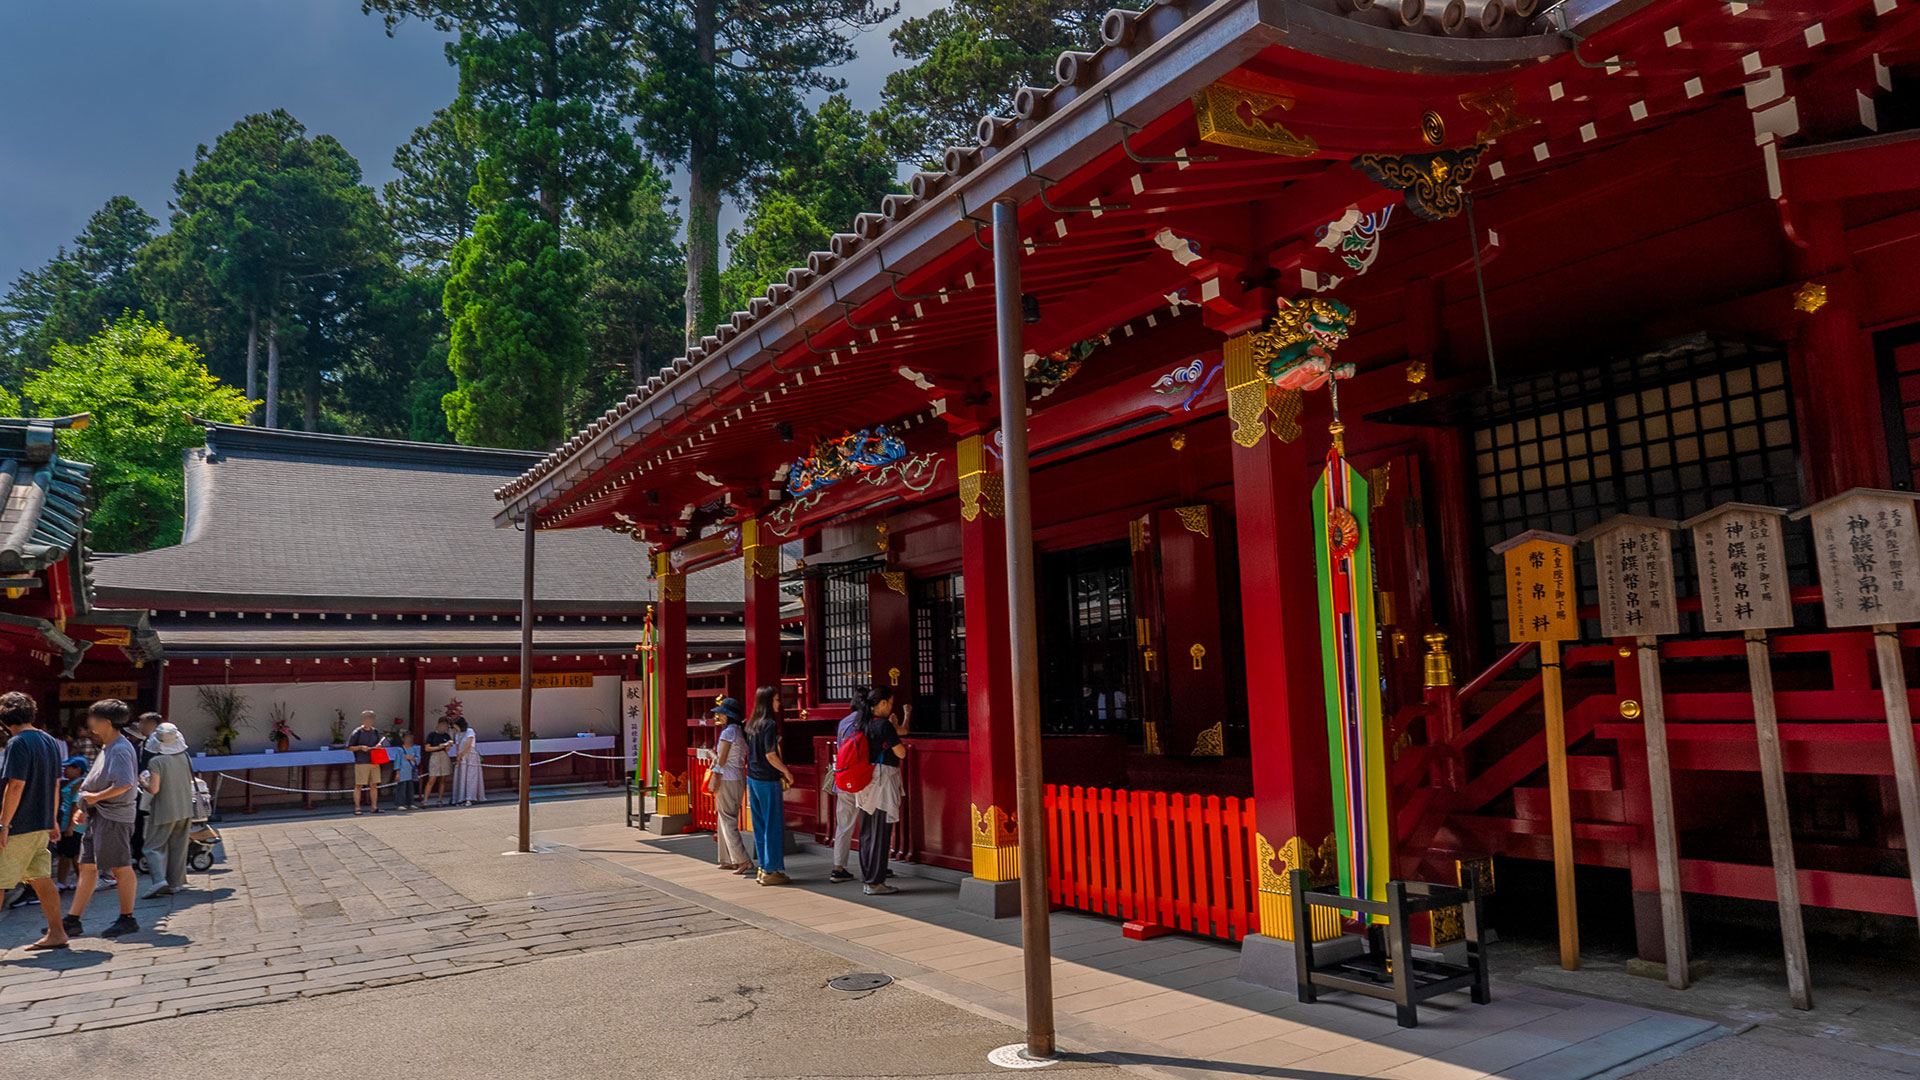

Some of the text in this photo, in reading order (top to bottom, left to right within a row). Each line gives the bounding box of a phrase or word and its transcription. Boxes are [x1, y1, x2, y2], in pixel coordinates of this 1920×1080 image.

[1529, 551, 1550, 632] 幣帛料
[1619, 537, 1643, 626] 神饌幣帛料
[1724, 521, 1754, 620] 神饌幣帛料
[1846, 514, 1883, 613] 神饌幣帛料
